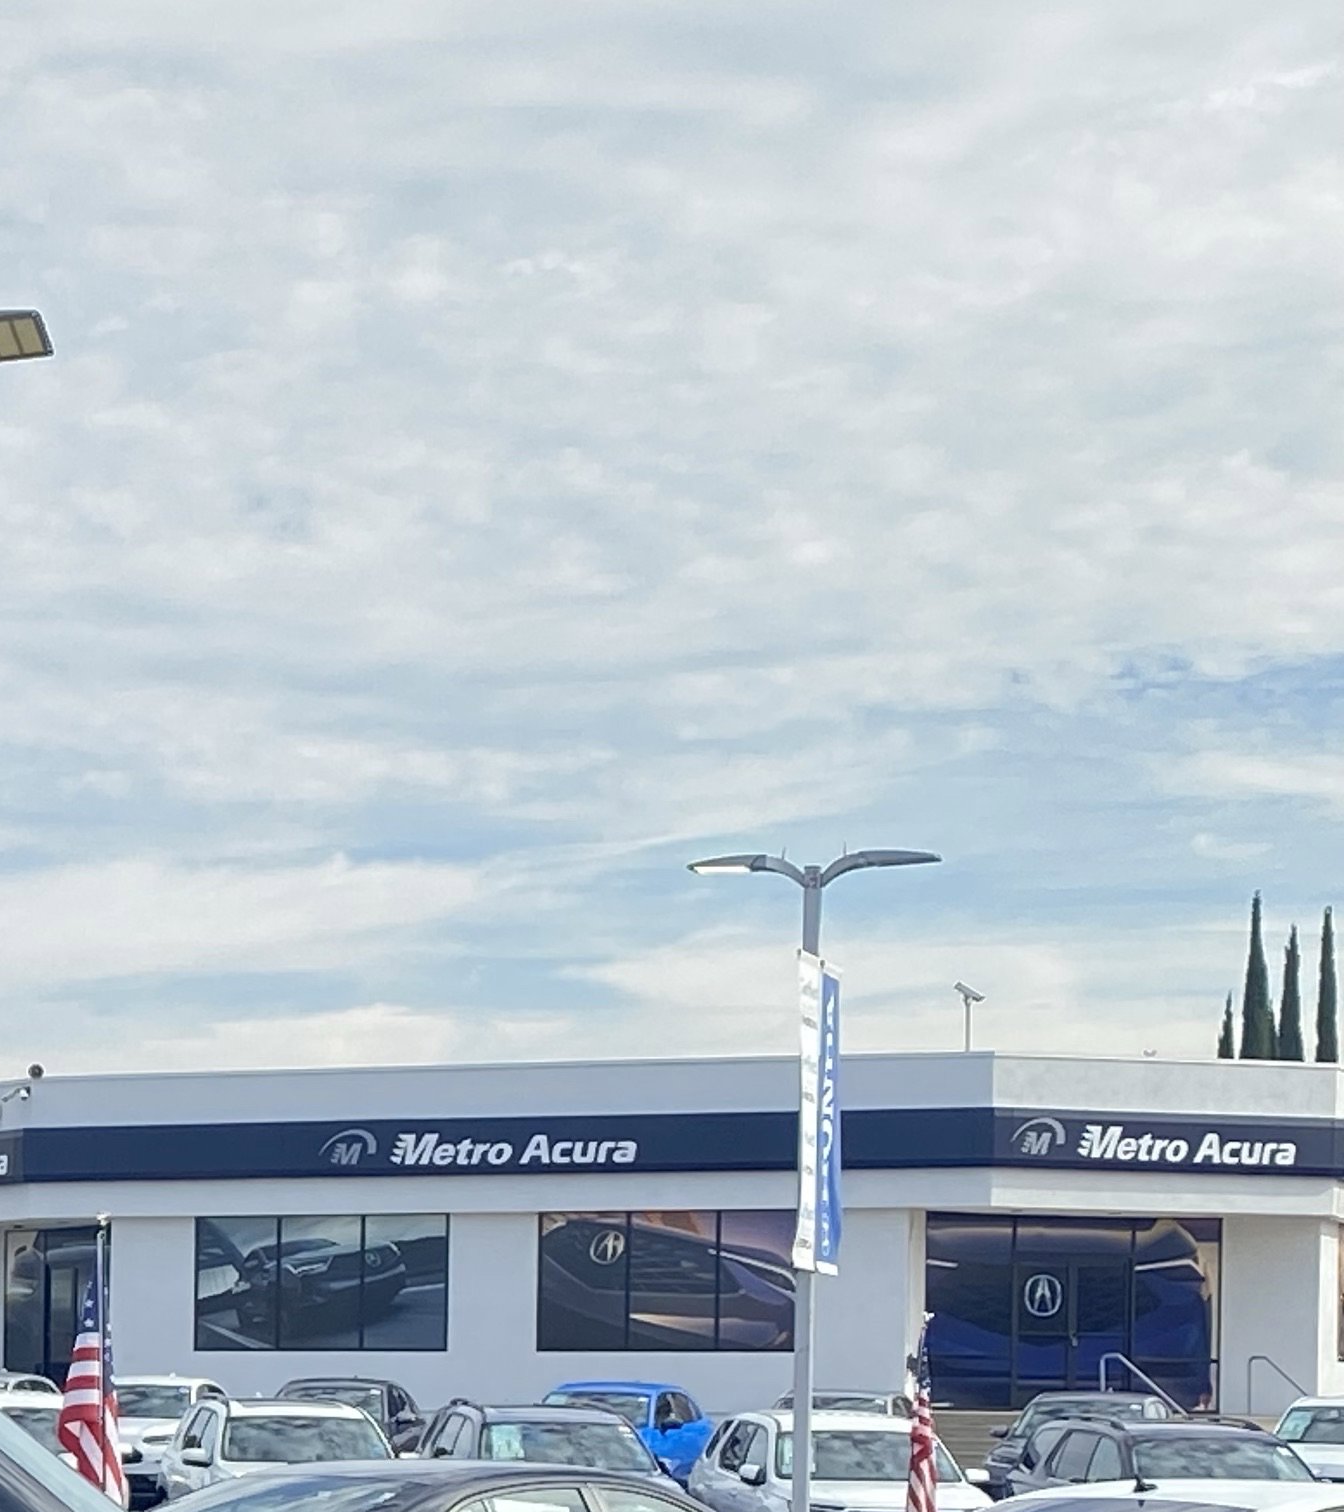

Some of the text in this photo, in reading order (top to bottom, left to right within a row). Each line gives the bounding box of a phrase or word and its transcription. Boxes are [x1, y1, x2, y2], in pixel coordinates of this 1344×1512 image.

[390, 1132, 638, 1166] Metro Acura
[1077, 1124, 1297, 1165] Metro Acura
